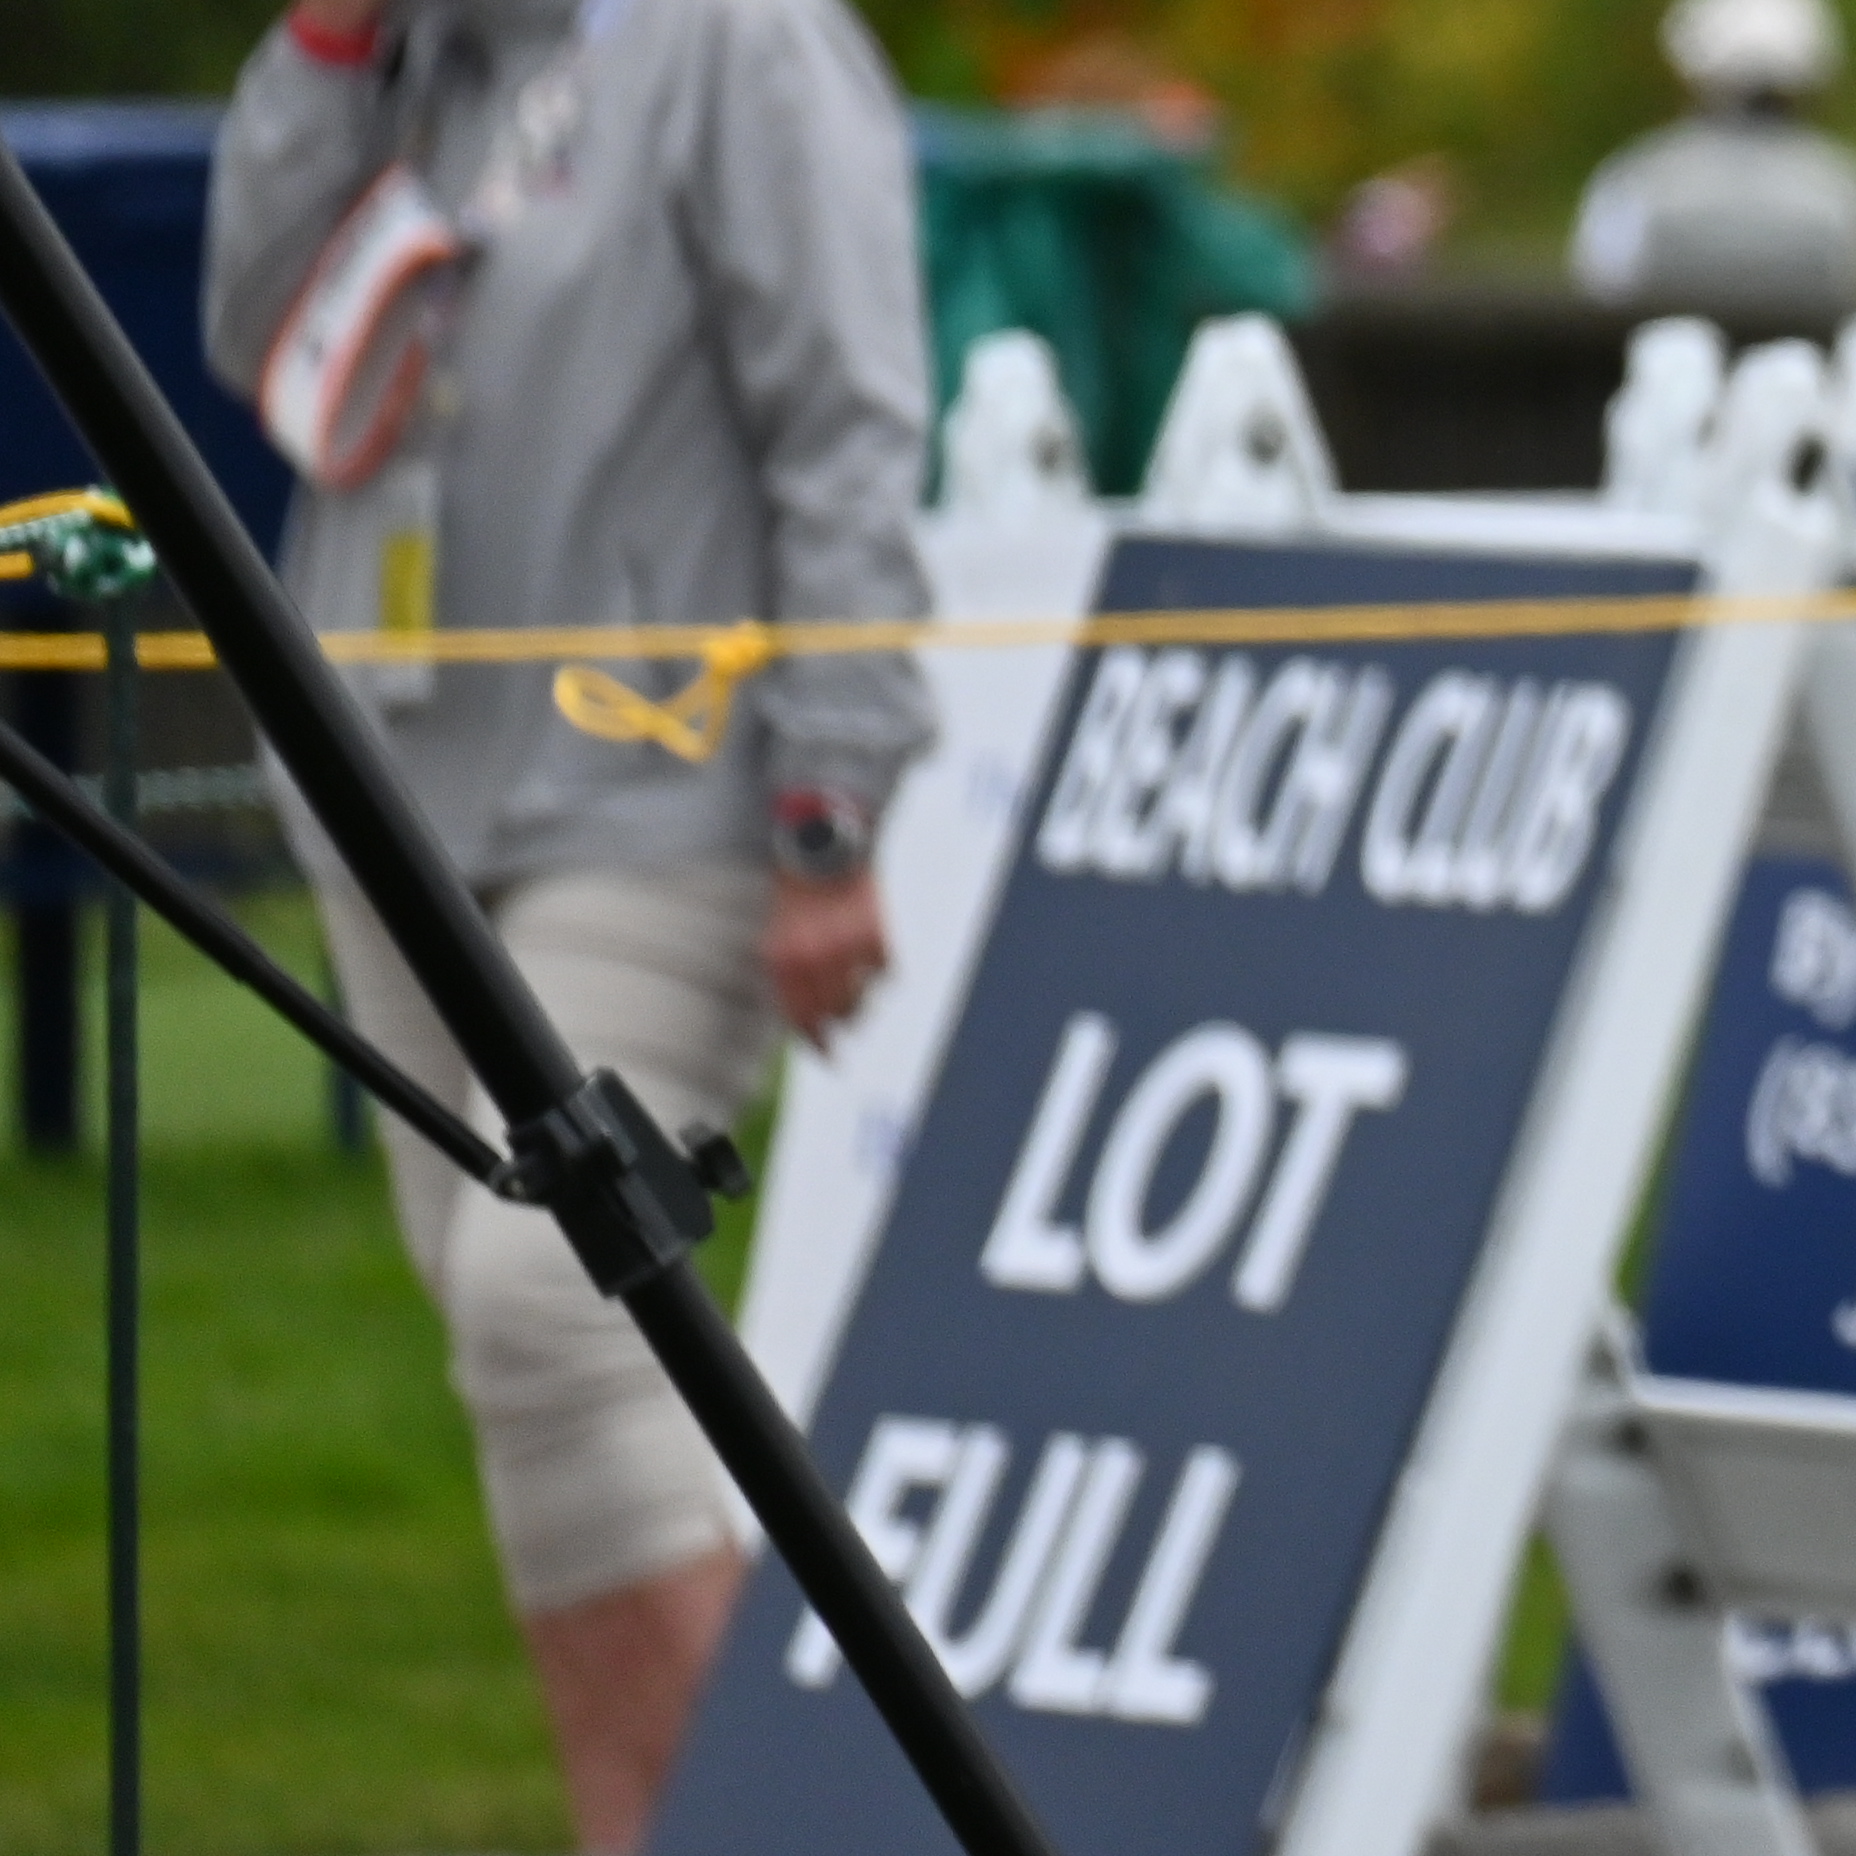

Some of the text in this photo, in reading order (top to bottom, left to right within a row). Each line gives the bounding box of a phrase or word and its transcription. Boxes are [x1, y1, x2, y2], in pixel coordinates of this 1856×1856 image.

[1037, 647, 1632, 914] BEACH CLUB
[978, 1009, 1411, 1313] LOT
[785, 1413, 1240, 1724] FULL
